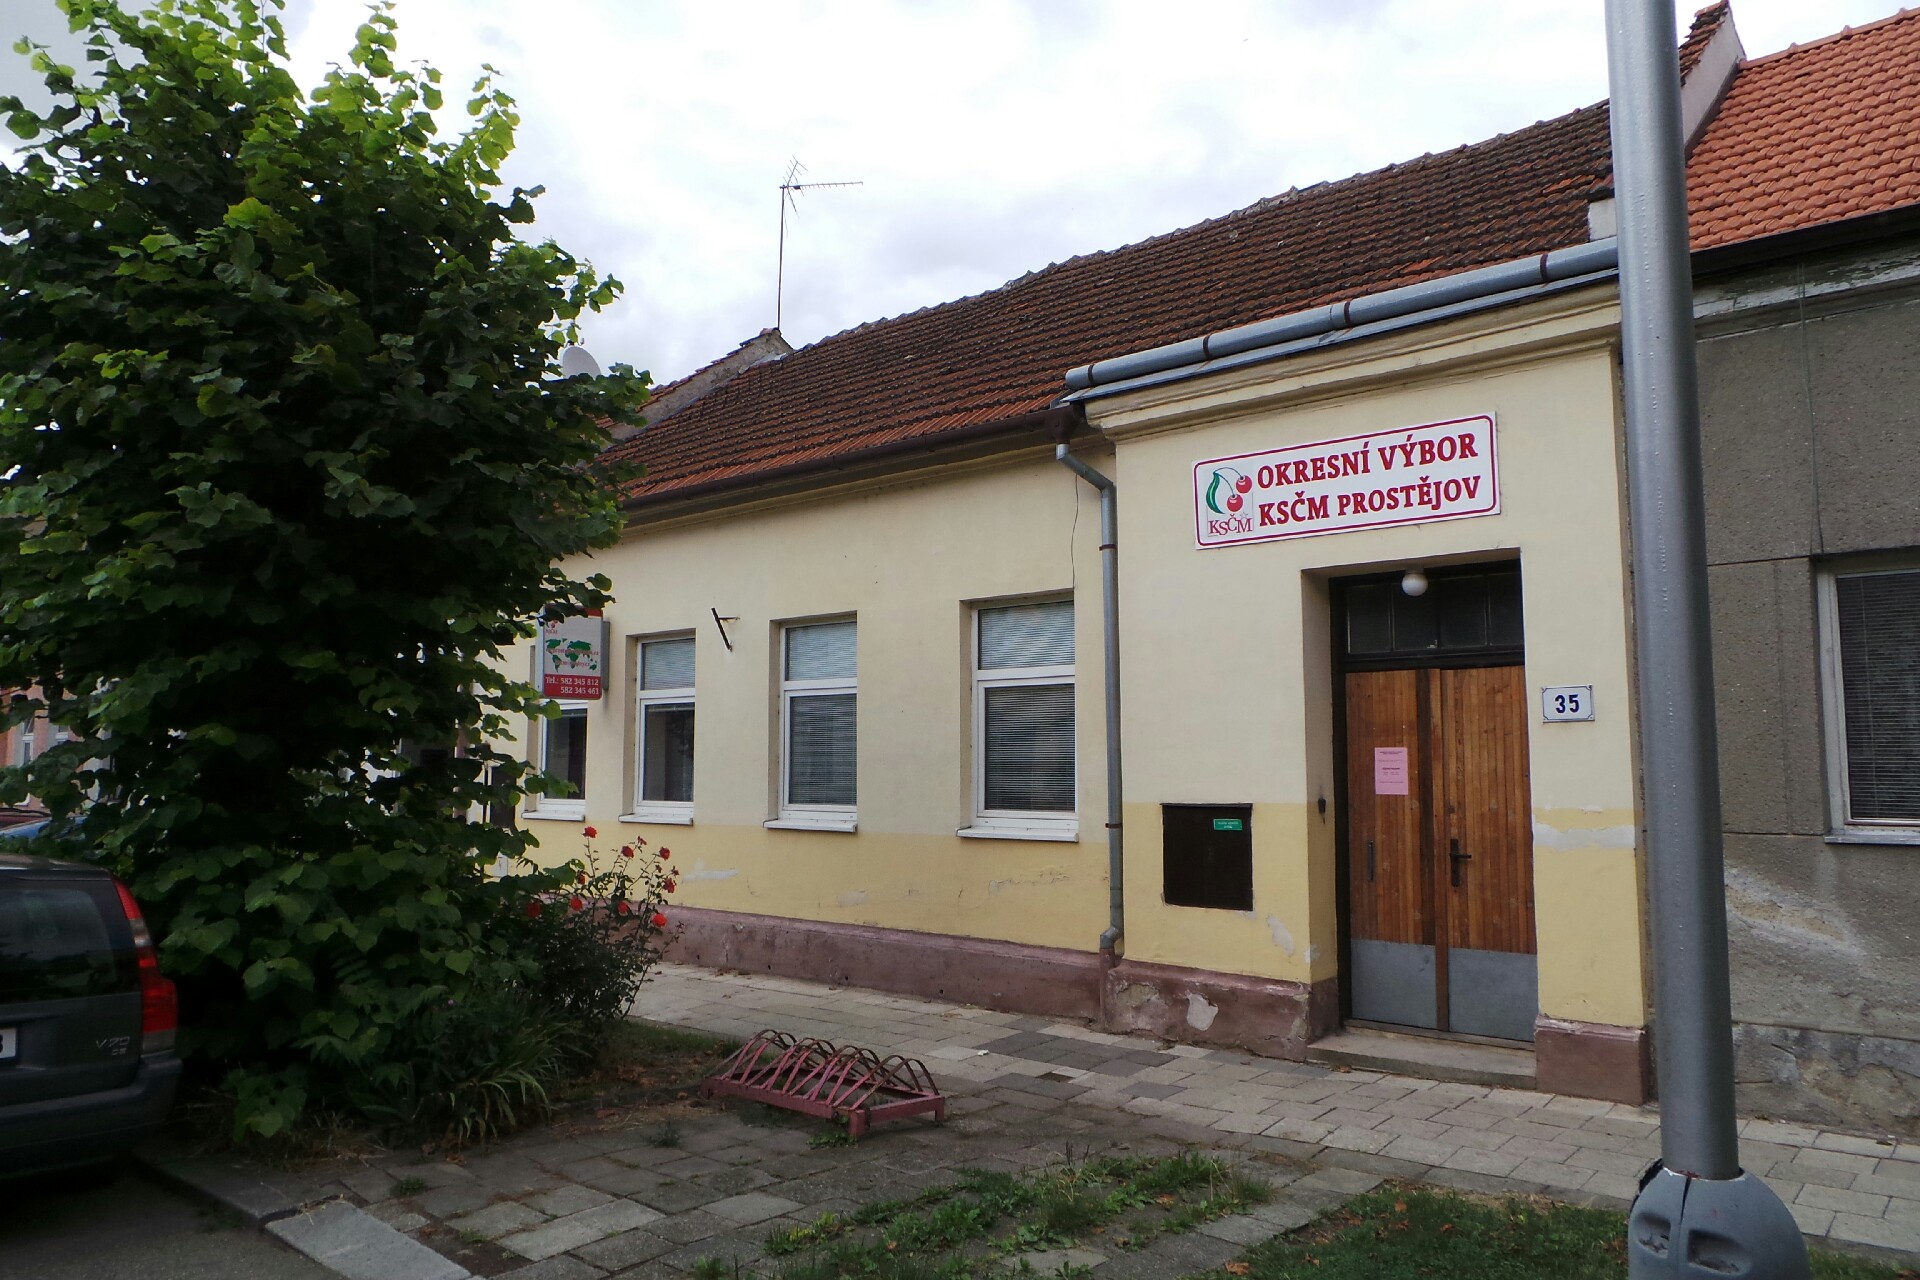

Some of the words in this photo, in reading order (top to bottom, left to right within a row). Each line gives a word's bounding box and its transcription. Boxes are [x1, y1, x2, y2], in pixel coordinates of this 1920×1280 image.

[1257, 441, 1371, 489] OKRESNÍ
[1378, 433, 1479, 471] VÝBOR
[1258, 490, 1330, 527] KSČM
[1337, 475, 1482, 517] PROSTĚJOV
[1208, 514, 1253, 536] KSČM
[560, 677, 573, 685] 582
[574, 678, 586, 686] 345
[587, 678, 599, 686] 812
[560, 686, 573, 694] 582
[587, 687, 599, 695] 461
[1554, 694, 1580, 714] 35
